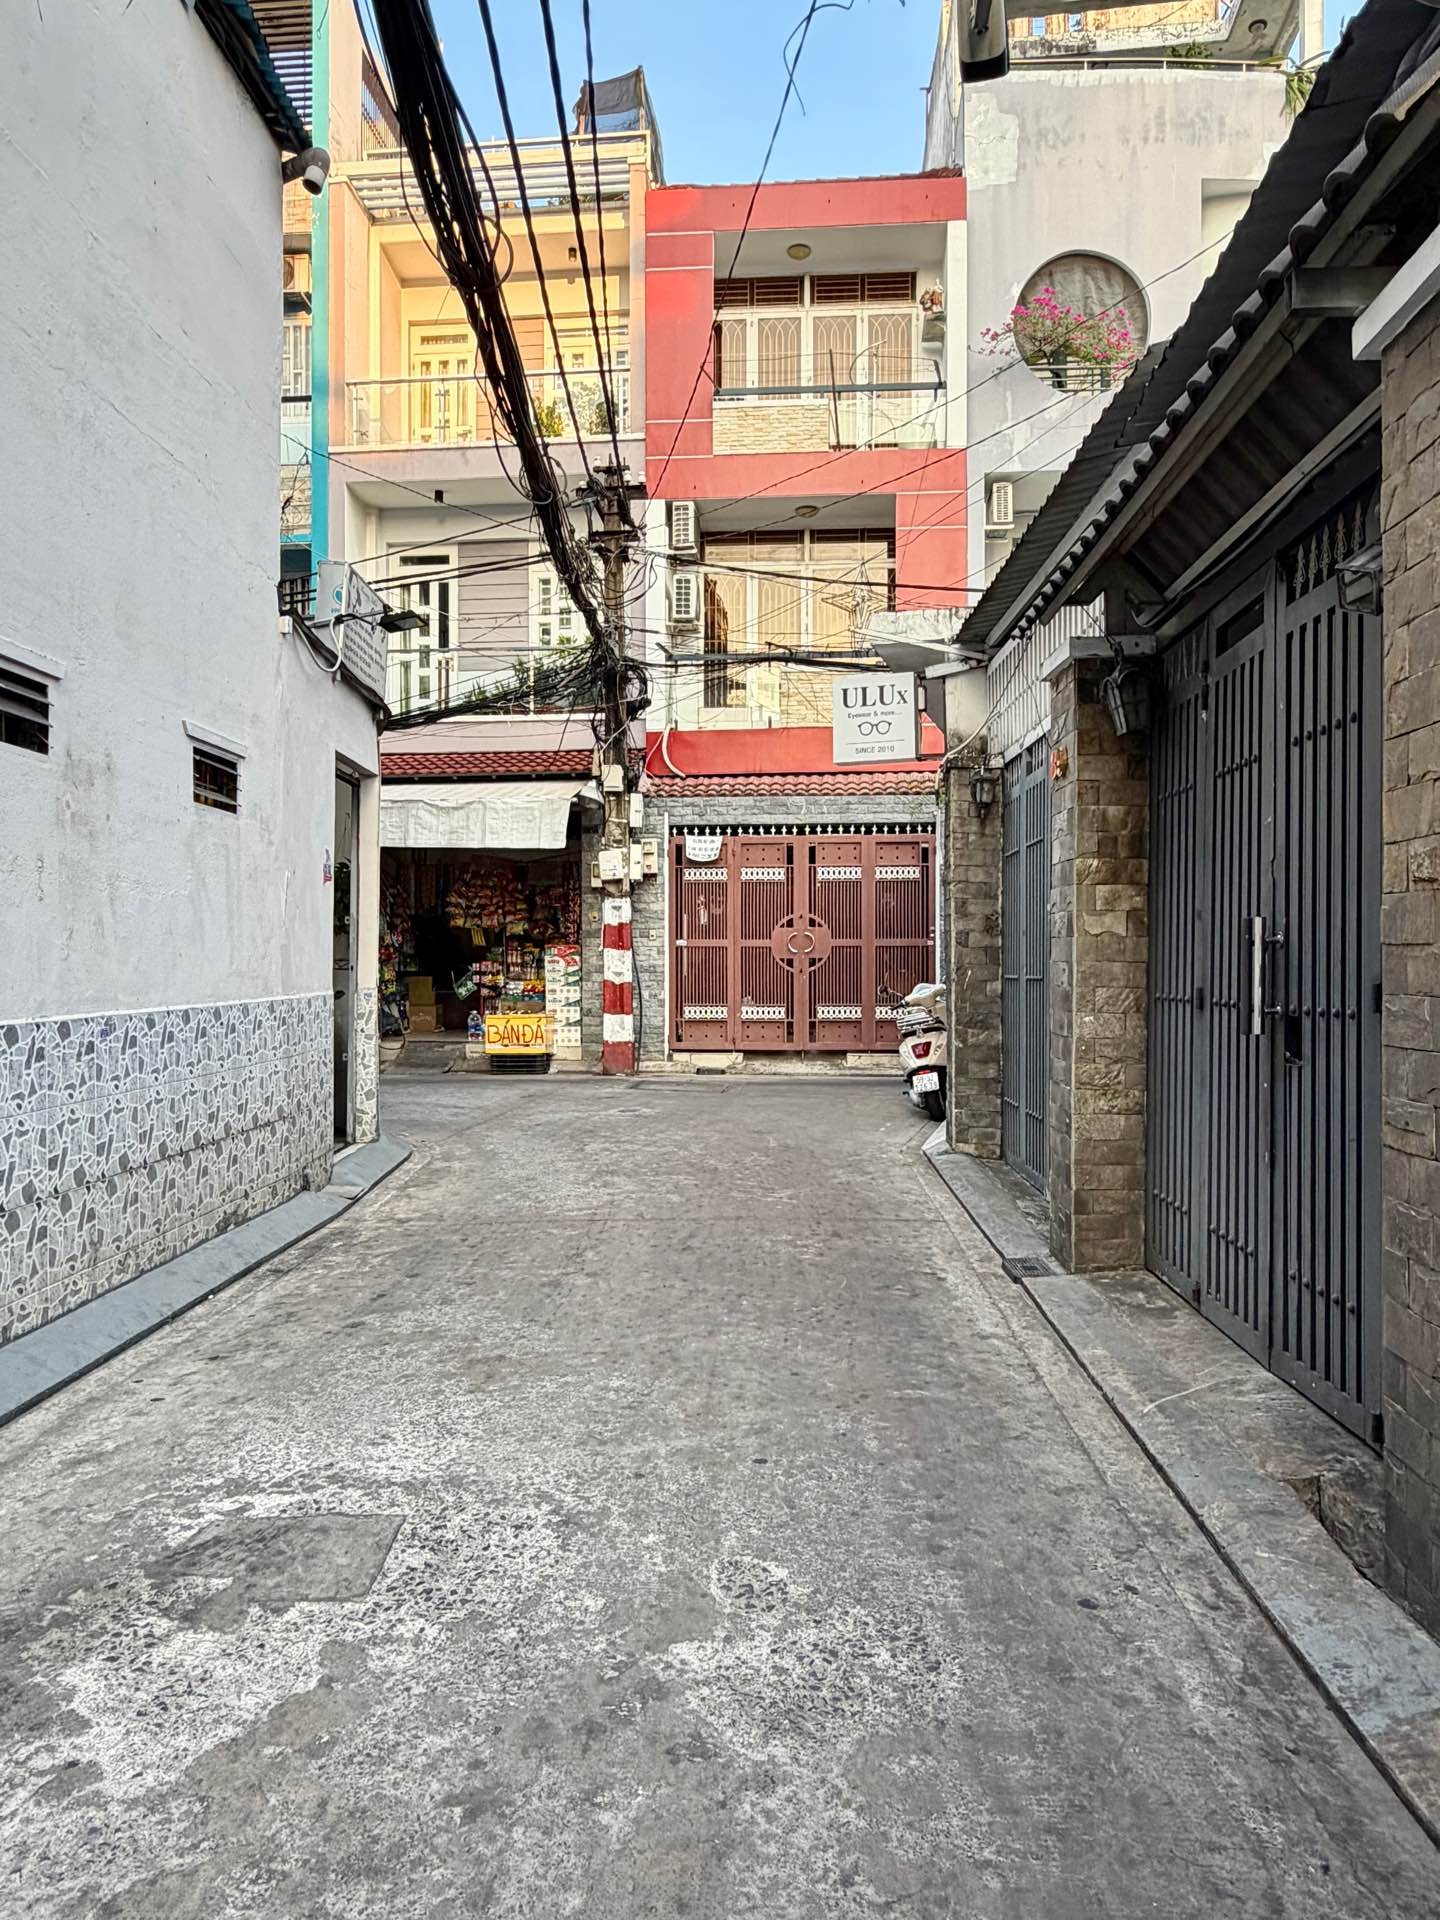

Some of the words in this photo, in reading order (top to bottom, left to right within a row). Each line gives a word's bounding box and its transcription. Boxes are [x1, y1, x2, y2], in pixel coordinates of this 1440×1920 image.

[855, 746, 875, 754] SINCE
[877, 745, 895, 753] 2010
[487, 1019, 520, 1044] BÁN
[521, 1018, 544, 1044] ĐÁ
